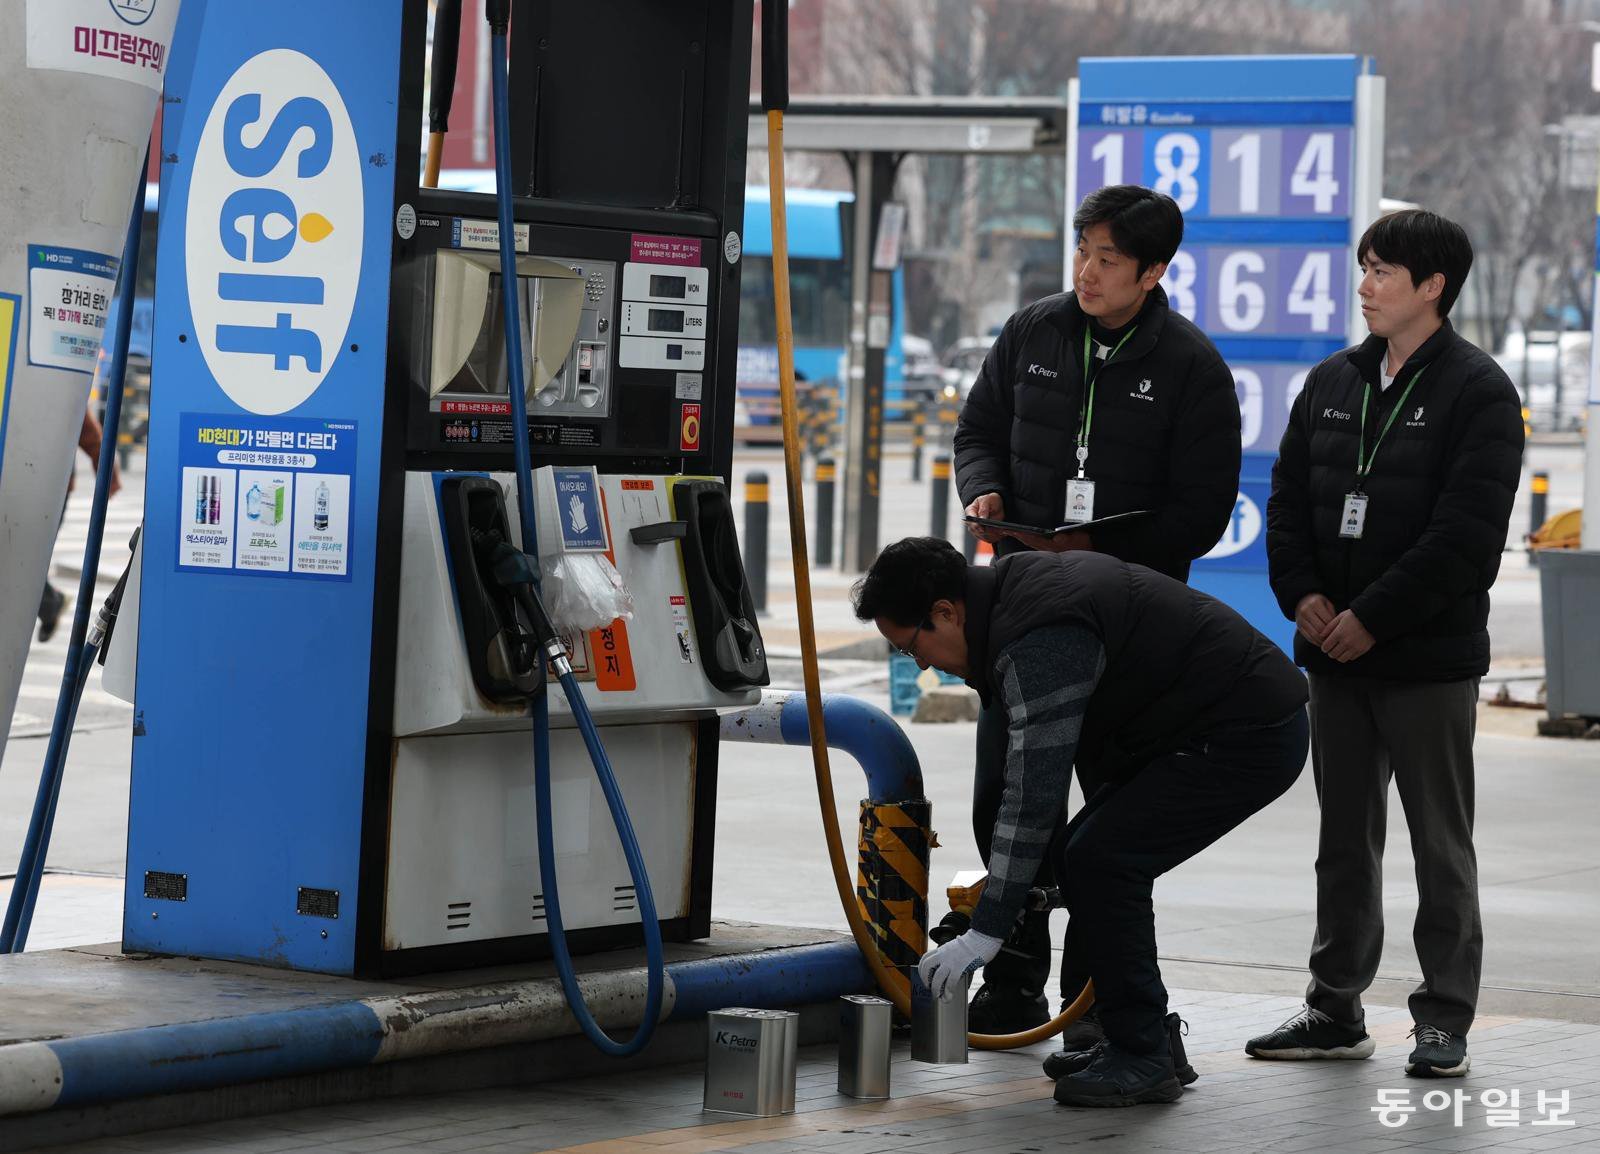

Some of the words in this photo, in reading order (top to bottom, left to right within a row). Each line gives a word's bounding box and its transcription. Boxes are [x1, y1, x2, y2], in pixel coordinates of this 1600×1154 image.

[1092, 133, 1339, 214] 1814
[215, 93, 334, 374] Self
[46, 254, 58, 263] HD
[687, 283, 699, 293] WON
[62, 288, 91, 308] 장거리
[685, 317, 702, 327] LITERS
[1028, 363, 1040, 375] K
[1038, 367, 1058, 378] Petro
[1323, 408, 1333, 418] K
[1332, 410, 1351, 421] Petro
[198, 428, 253, 446] HD현대가
[255, 430, 294, 449] 만들면
[297, 432, 337, 451] 다르다
[227, 453, 256, 463] 프리미엄
[257, 454, 285, 465] 차량용품
[559, 481, 588, 492] 어서오세요!
[715, 1031, 729, 1044] K
[730, 1035, 757, 1048] Petro
